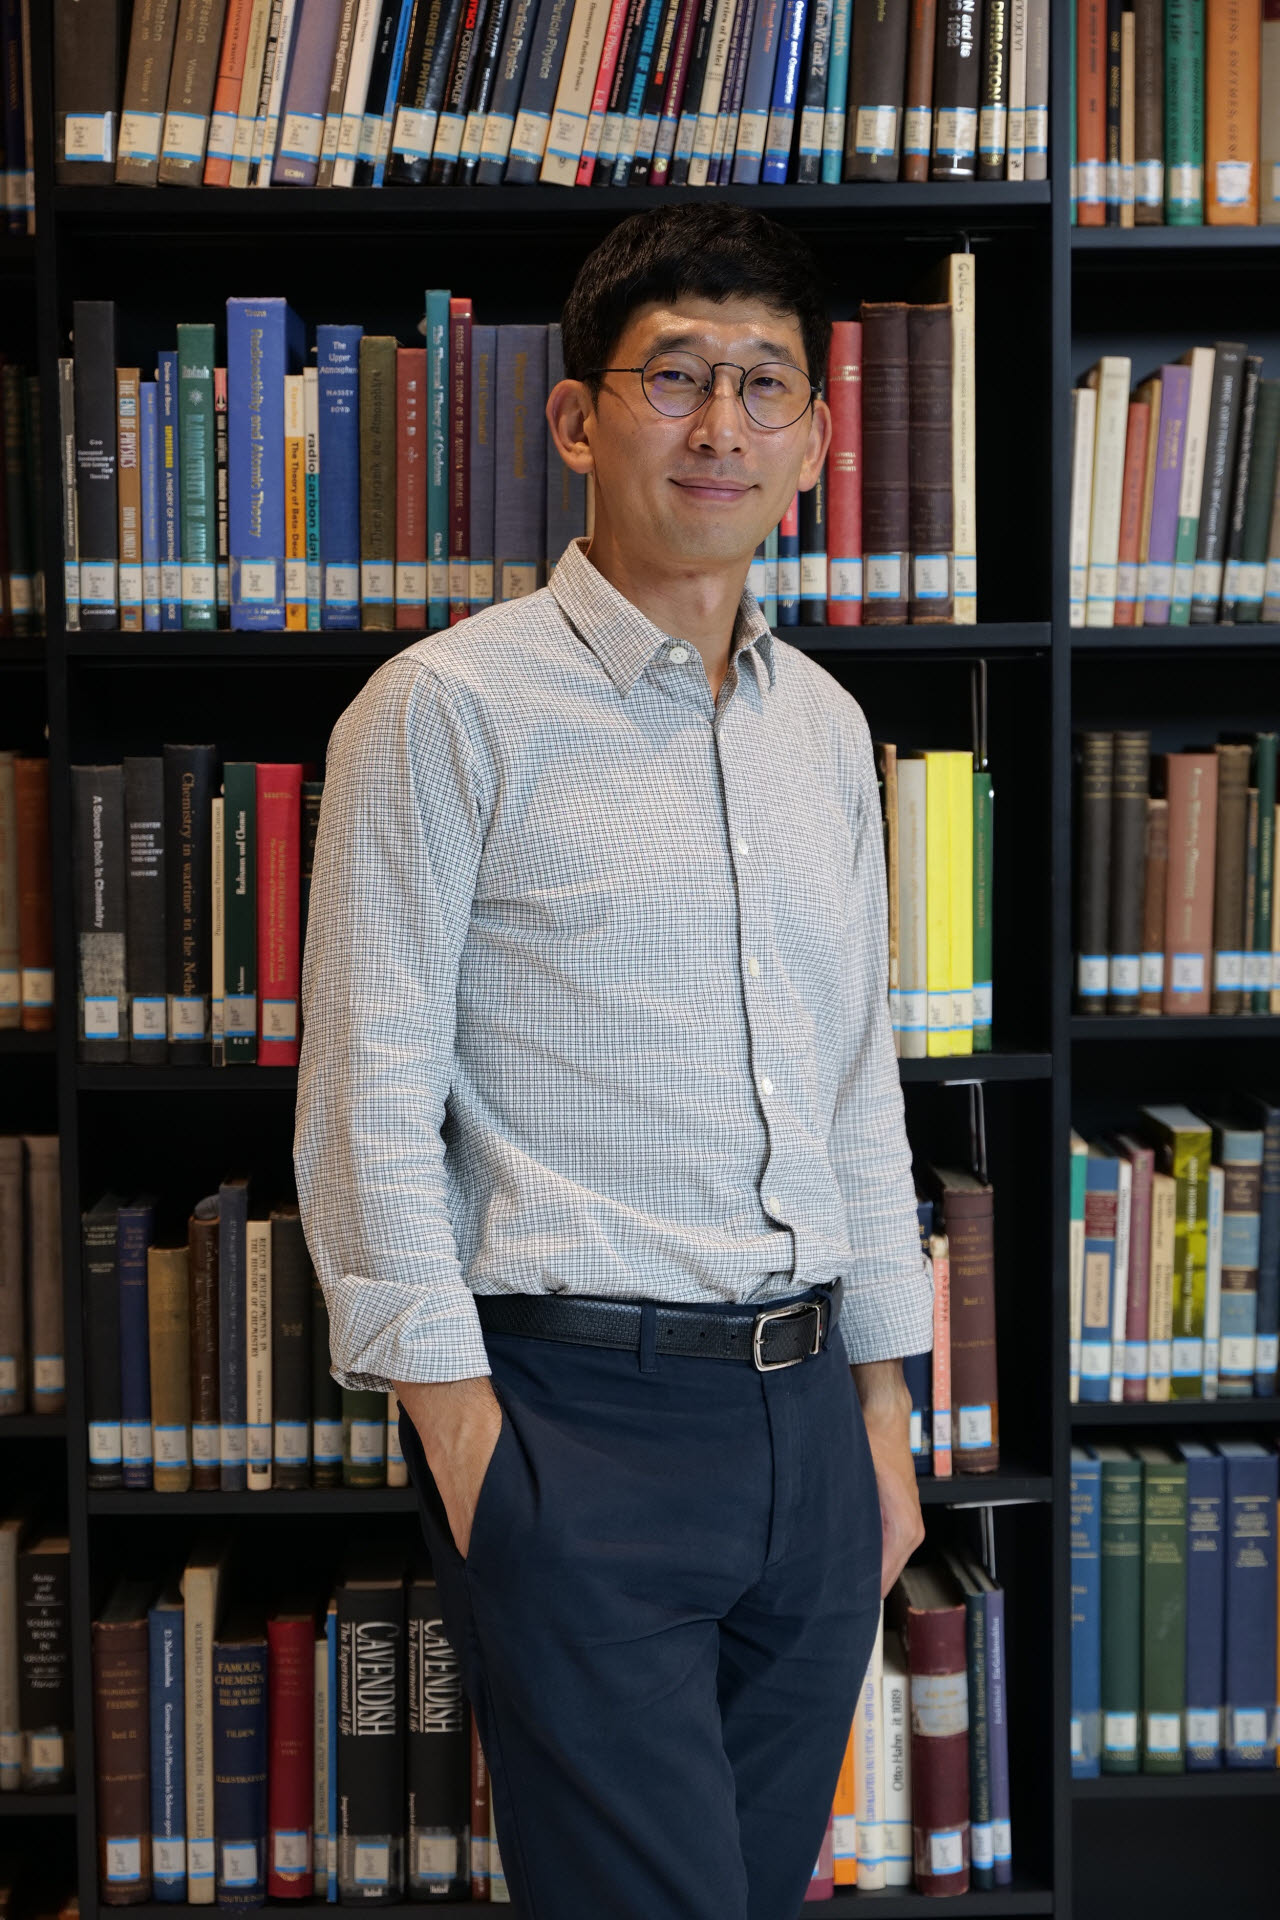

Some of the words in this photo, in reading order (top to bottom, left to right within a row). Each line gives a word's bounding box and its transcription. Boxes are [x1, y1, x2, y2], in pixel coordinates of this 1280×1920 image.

[341, 23, 351, 39] the
[833, 14, 848, 57] quarks
[960, 14, 973, 39] and
[459, 30, 474, 62] FOSTER
[505, 38, 524, 80] Physics
[540, 38, 558, 79] Physics
[603, 35, 618, 69] Physics
[714, 37, 727, 67] Nuclei
[811, 41, 825, 65] and
[959, 42, 973, 58] its
[988, 1, 1005, 100] DIFFRACTION
[331, 40, 349, 92] Beginning
[810, 66, 824, 76] Z
[451, 70, 465, 104] FOWLER
[333, 341, 347, 350] The
[432, 325, 444, 345] The
[248, 328, 265, 410] Radioactivity
[328, 352, 352, 363] Upper
[119, 380, 135, 396] THE
[119, 397, 136, 417] END
[431, 392, 445, 427] Theory
[120, 418, 135, 431] OF
[249, 413, 264, 440] and
[432, 430, 444, 442] of
[119, 431, 137, 469] PHYSICS
[291, 441, 300, 458] The
[249, 442, 265, 488] Atomic
[289, 461, 300, 494] Theory
[306, 432, 318, 528] radiocarbon
[248, 490, 265, 538] Theory
[291, 497, 300, 505] of
[92, 795, 102, 804] A
[181, 772, 197, 839] Chemistry
[92, 805, 103, 840] Source
[93, 841, 104, 866] Book
[182, 844, 196, 857] in
[93, 868, 104, 878] in
[182, 861, 197, 913] wartime
[93, 879, 106, 929] Chemistry
[183, 919, 197, 931] in
[183, 935, 196, 957] the
[250, 1237, 259, 1254] THE
[259, 1237, 268, 1269] RECENT
[250, 1257, 259, 1293] HISTORY
[250, 1296, 259, 1307] OF
[259, 1273, 268, 1339] DEVELOPMENTS
[250, 1310, 260, 1359] CHEMISTRY
[339, 1622, 353, 1647] The
[408, 1619, 420, 1644] The
[214, 1674, 265, 1686] CHEMISTS
[217, 1661, 262, 1673] FAMOUS
[338, 1648, 353, 1712] Experimental
[356, 1621, 401, 1737] CAVENDISH
[407, 1645, 419, 1709] Experimental
[338, 1713, 353, 1736] Life
[407, 1710, 419, 1733] Life
[890, 1734, 904, 1764] Hahn
[891, 1766, 905, 1793] Otto
